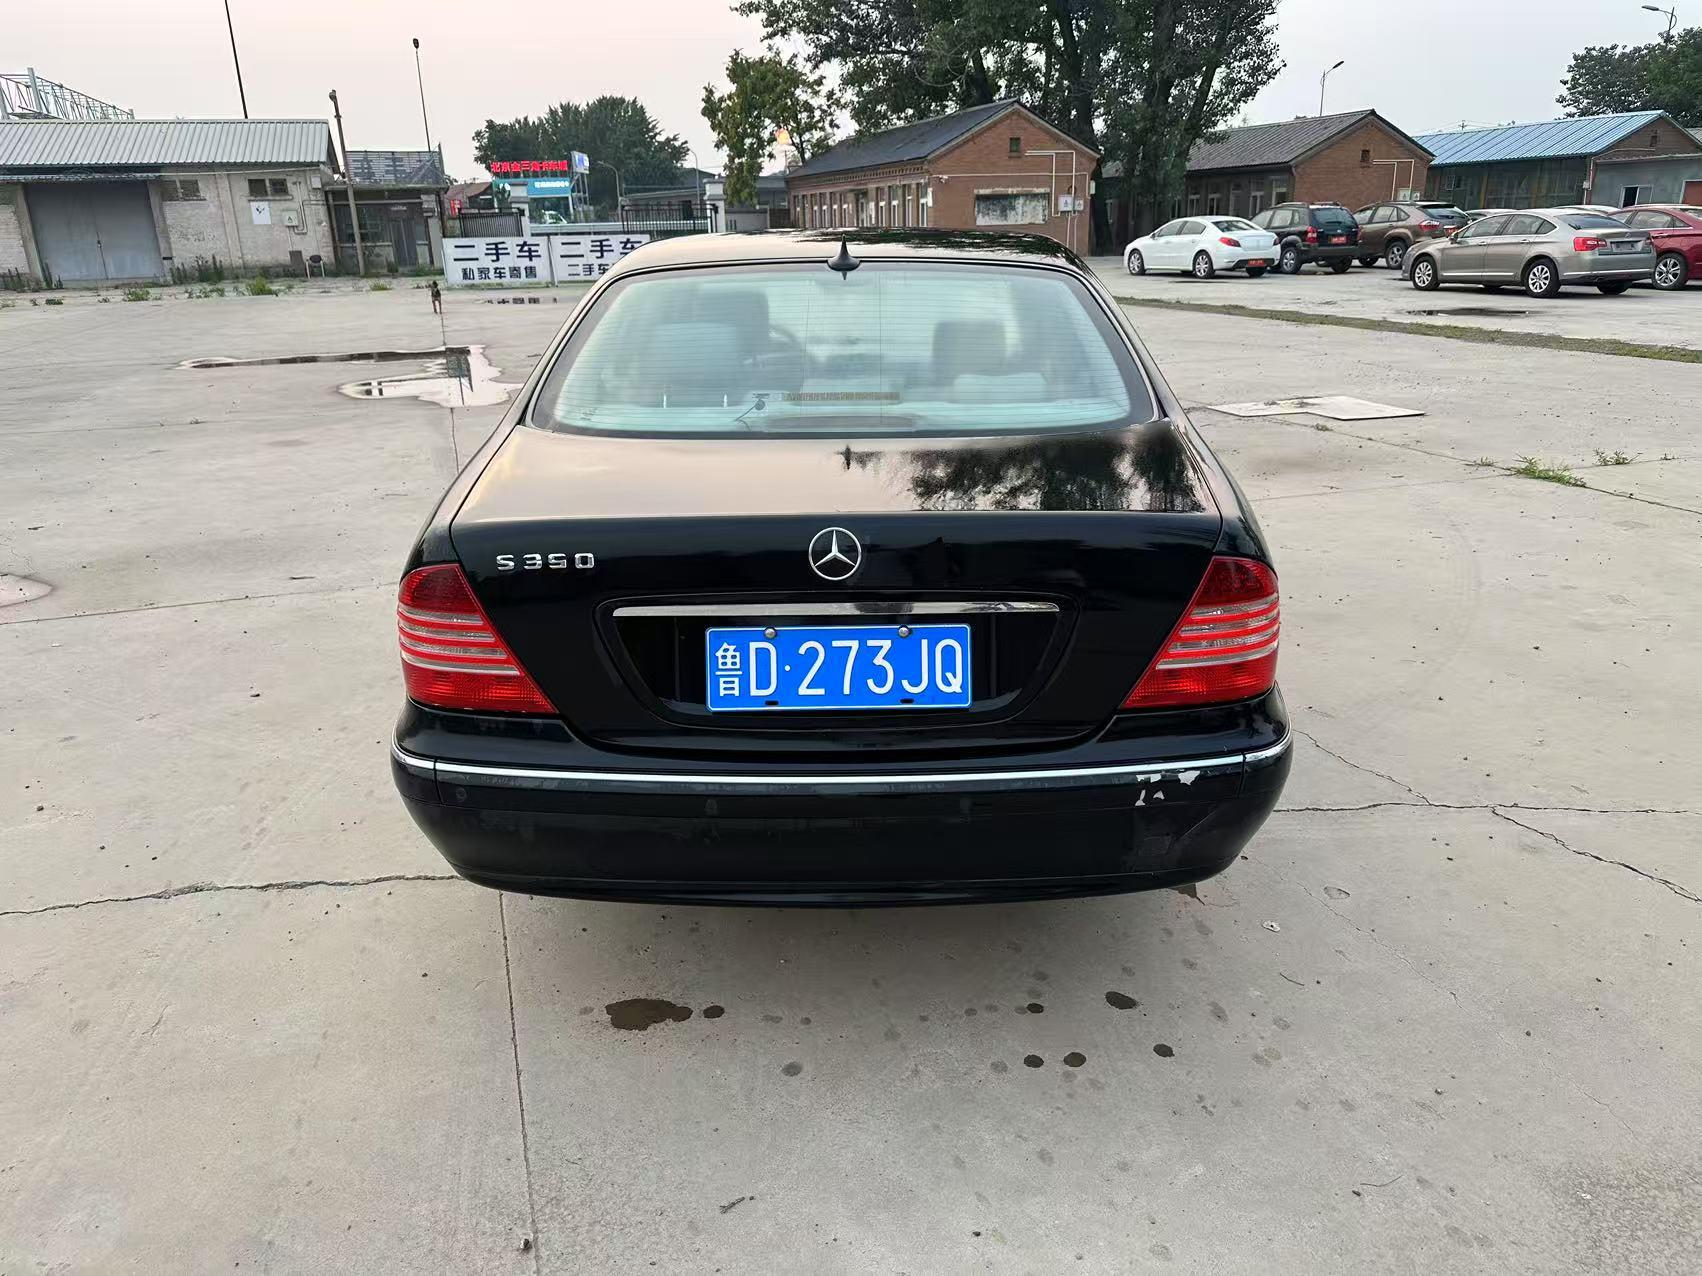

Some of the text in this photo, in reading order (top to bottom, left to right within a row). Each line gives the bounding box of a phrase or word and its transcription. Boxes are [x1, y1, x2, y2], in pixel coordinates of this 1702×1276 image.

[454, 241, 542, 262] 二手车
[560, 238, 642, 259] 二手车
[461, 266, 537, 280] 私家车寄售
[568, 263, 614, 276] 二手车
